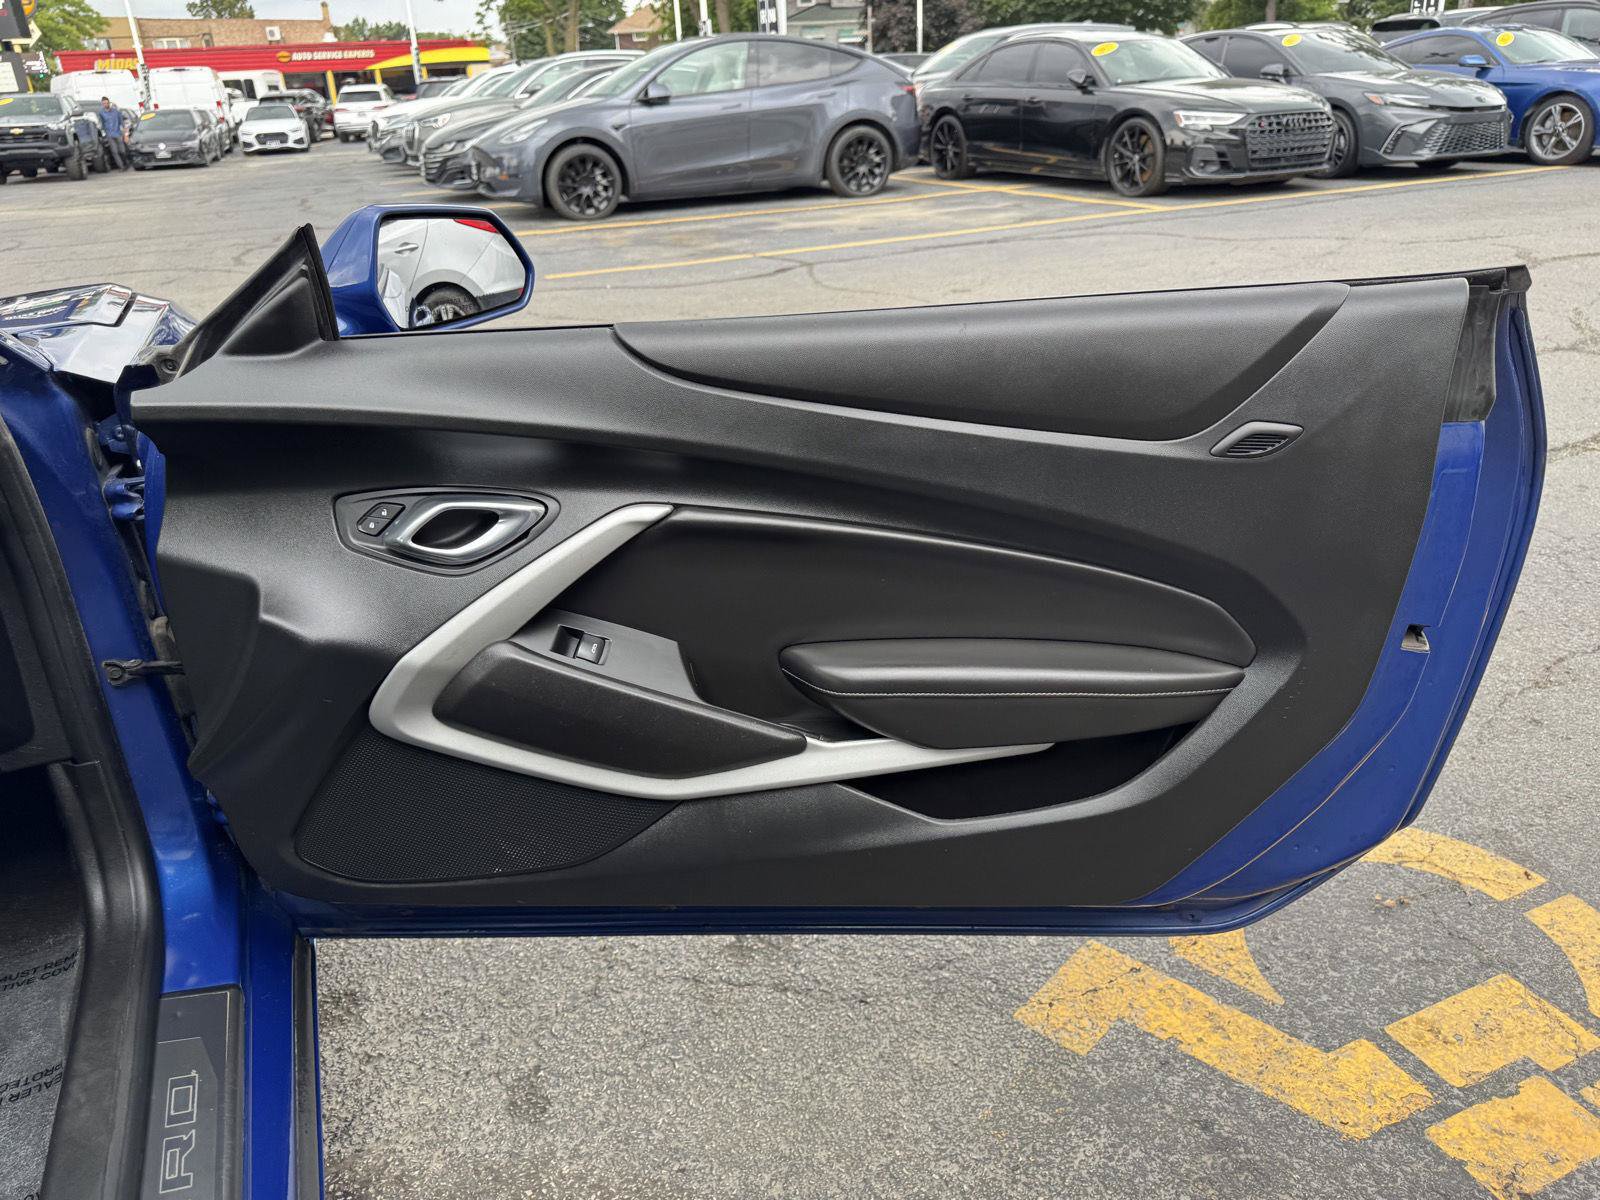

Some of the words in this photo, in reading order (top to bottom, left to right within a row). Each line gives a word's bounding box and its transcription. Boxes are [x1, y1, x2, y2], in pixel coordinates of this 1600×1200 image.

[291, 51, 312, 61] AUTO
[312, 50, 343, 60] SERVICE
[343, 49, 375, 59] EXPERTS
[44, 950, 79, 970] REM
